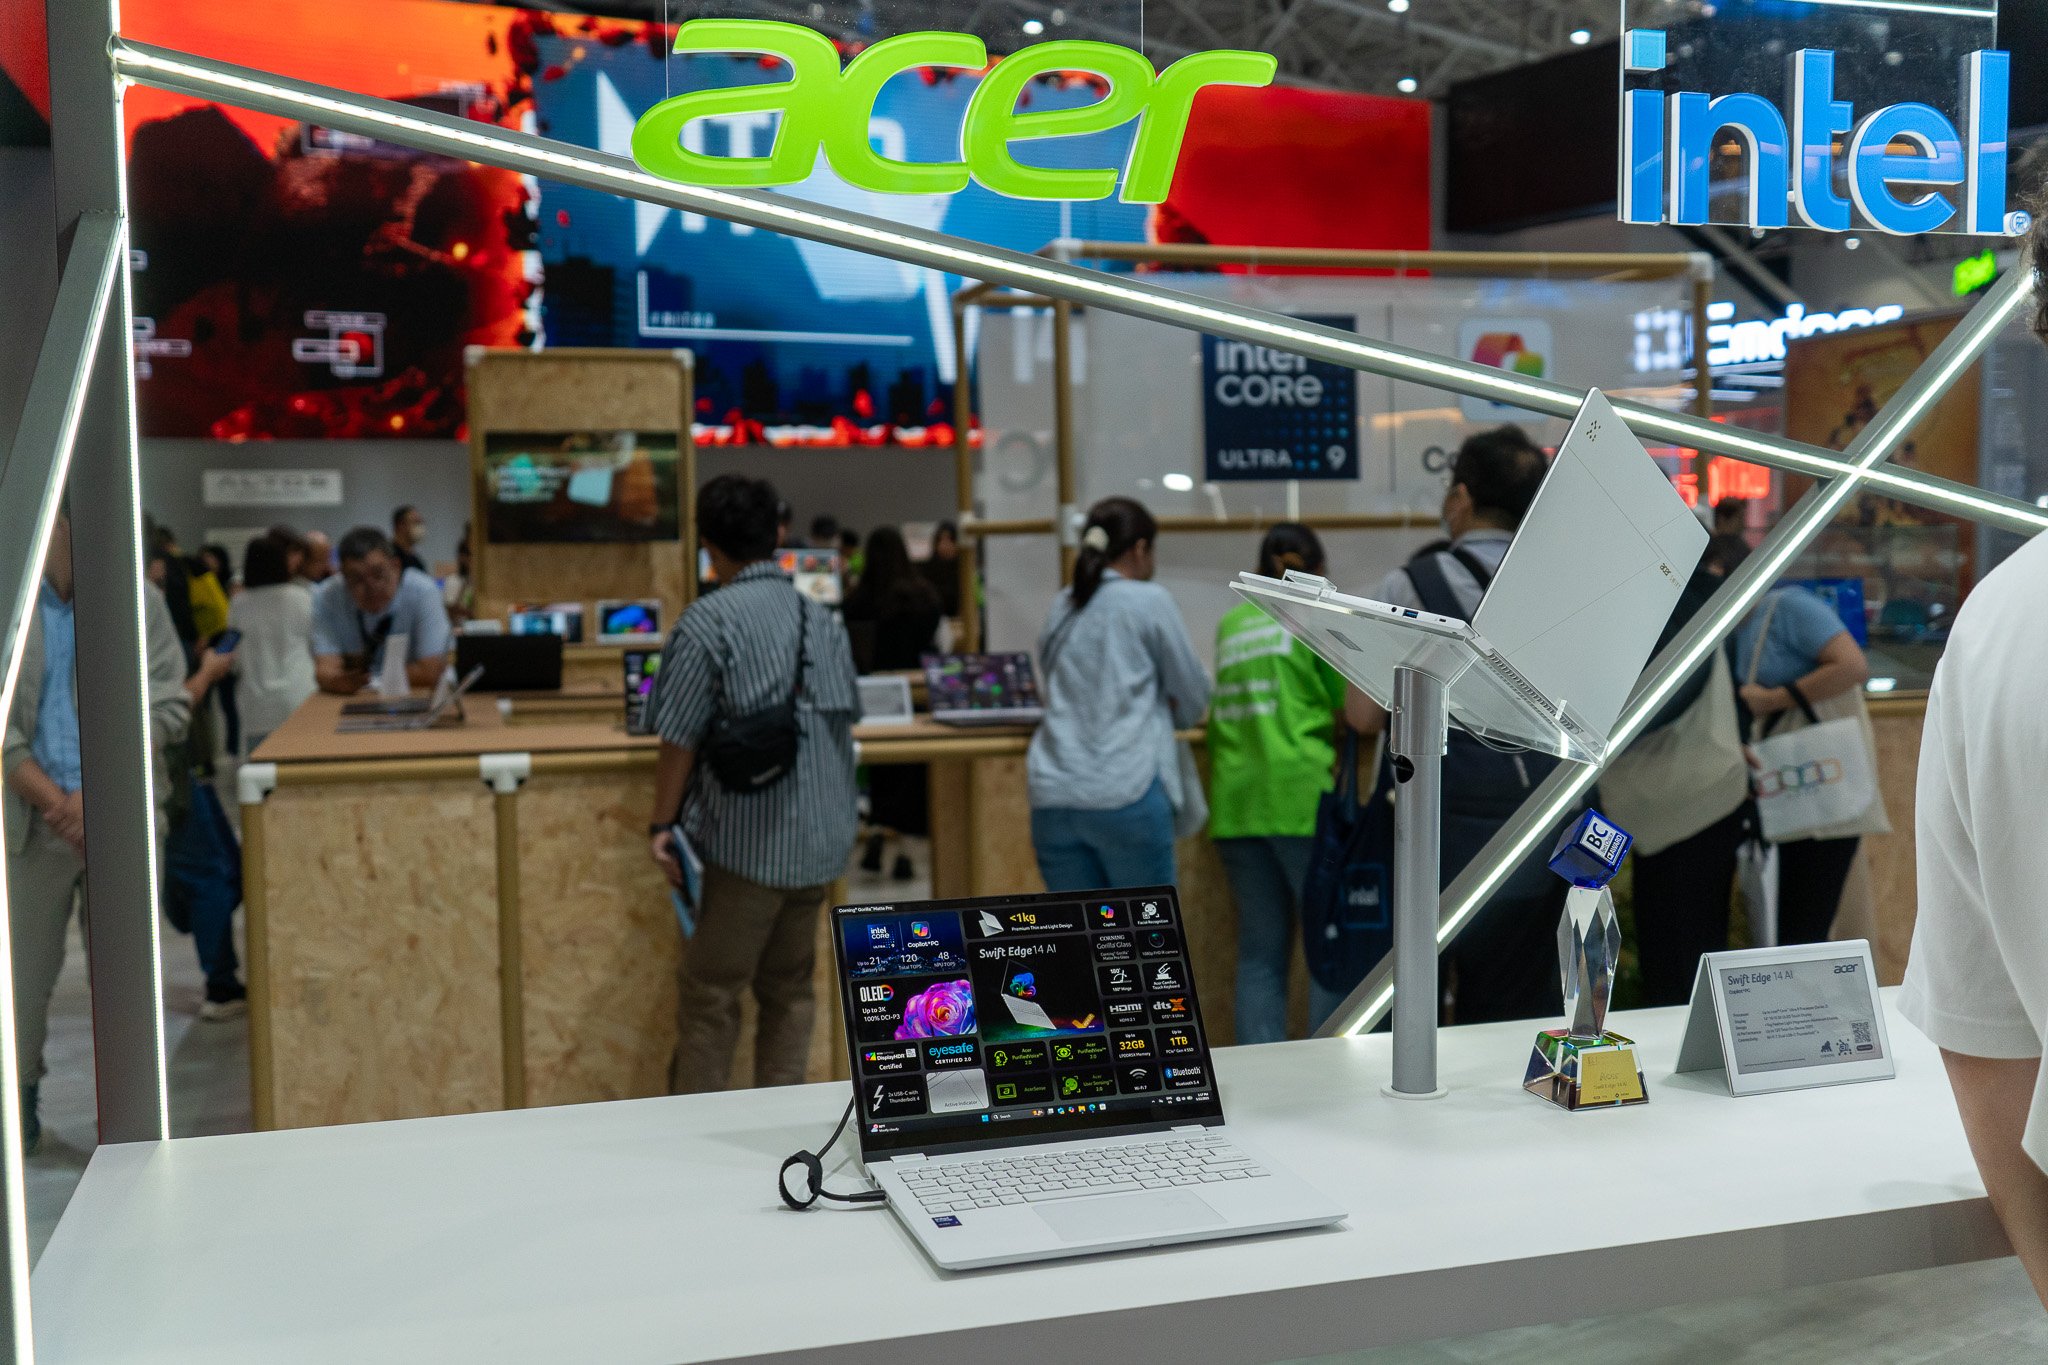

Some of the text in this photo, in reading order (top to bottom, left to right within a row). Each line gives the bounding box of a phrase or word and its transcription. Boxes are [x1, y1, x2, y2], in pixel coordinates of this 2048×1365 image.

[631, 19, 1278, 204] acer
[1217, 445, 1346, 469] ULTRA 9
[1586, 822, 1609, 850] BC
[1609, 834, 1623, 854] AWARD
[1010, 912, 1036, 924] <1kg
[870, 926, 887, 934] intel
[1100, 934, 1125, 942] CORNING
[938, 951, 950, 960] 48
[979, 947, 1006, 960] Swift
[1046, 944, 1057, 954] AI
[869, 956, 880, 965] 21
[901, 954, 918, 963] 120
[1834, 963, 1858, 974] acer
[1728, 970, 1794, 987] Swift Edge 14 AI
[860, 986, 883, 1002] OLED
[1119, 1040, 1145, 1050] 32GB
[1170, 1036, 1188, 1046] 1TB
[929, 1042, 974, 1058] eyesafe
